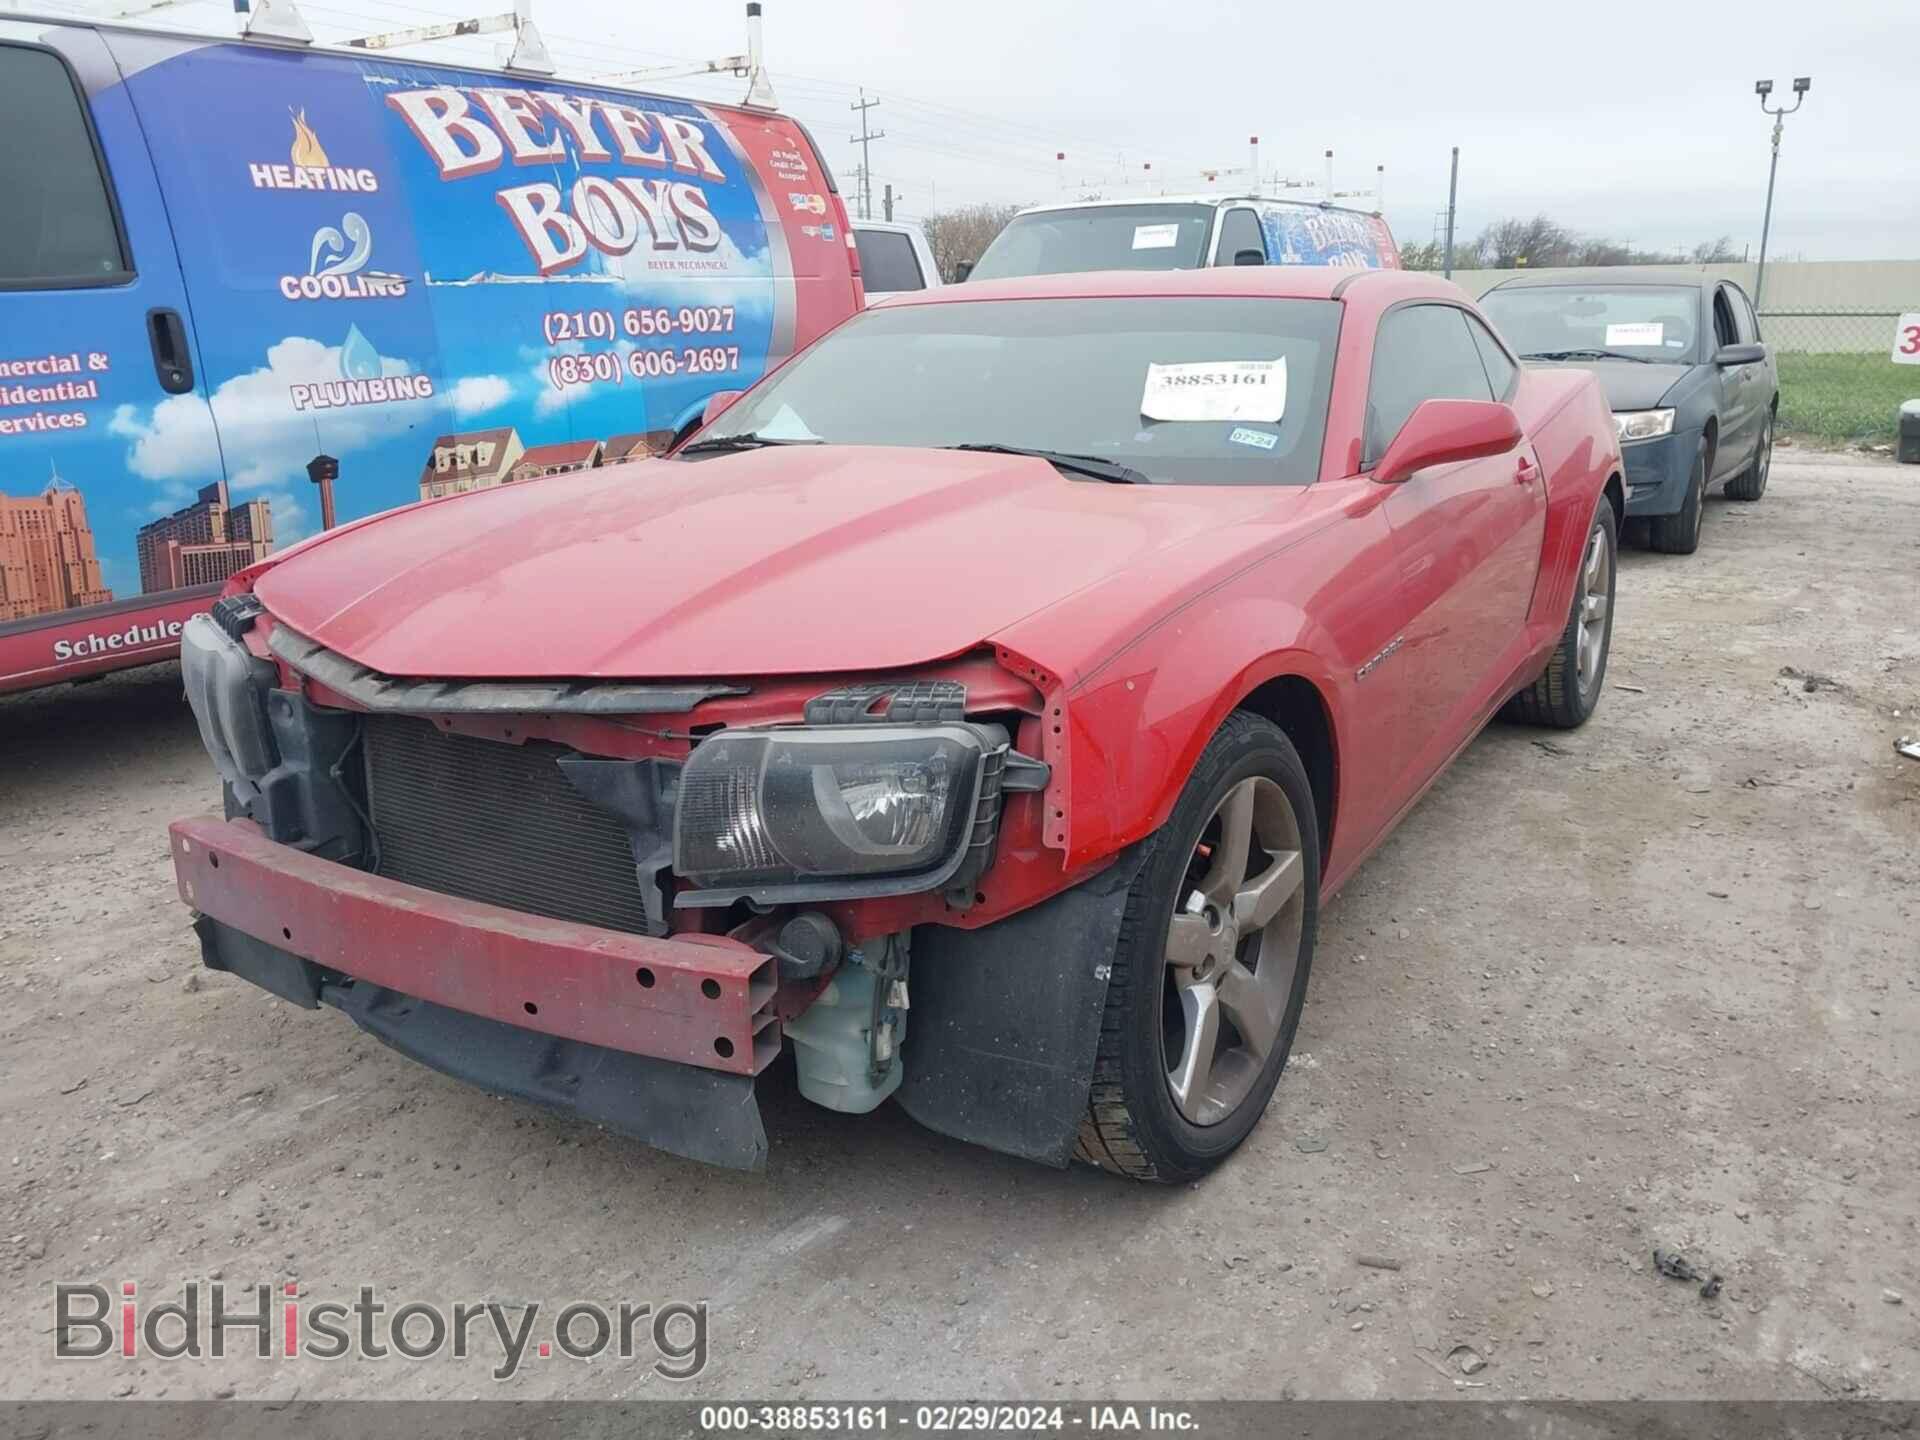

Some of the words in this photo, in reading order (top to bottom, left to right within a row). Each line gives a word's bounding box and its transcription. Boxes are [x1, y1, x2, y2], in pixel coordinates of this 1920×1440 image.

[385, 86, 728, 182] BEYER
[248, 162, 379, 193] HEATING
[495, 176, 722, 277] BOYS
[280, 272, 408, 300] COOLING
[543, 308, 617, 345] (210)
[622, 306, 736, 337] 656-9027
[1899, 325, 1920, 354] 3
[88, 351, 109, 371] &
[549, 355, 623, 391] (830)
[628, 346, 741, 378] 606-2697
[0, 379, 99, 406] idential
[290, 374, 435, 411] PLUMBING
[1161, 373, 1268, 386] 38853161
